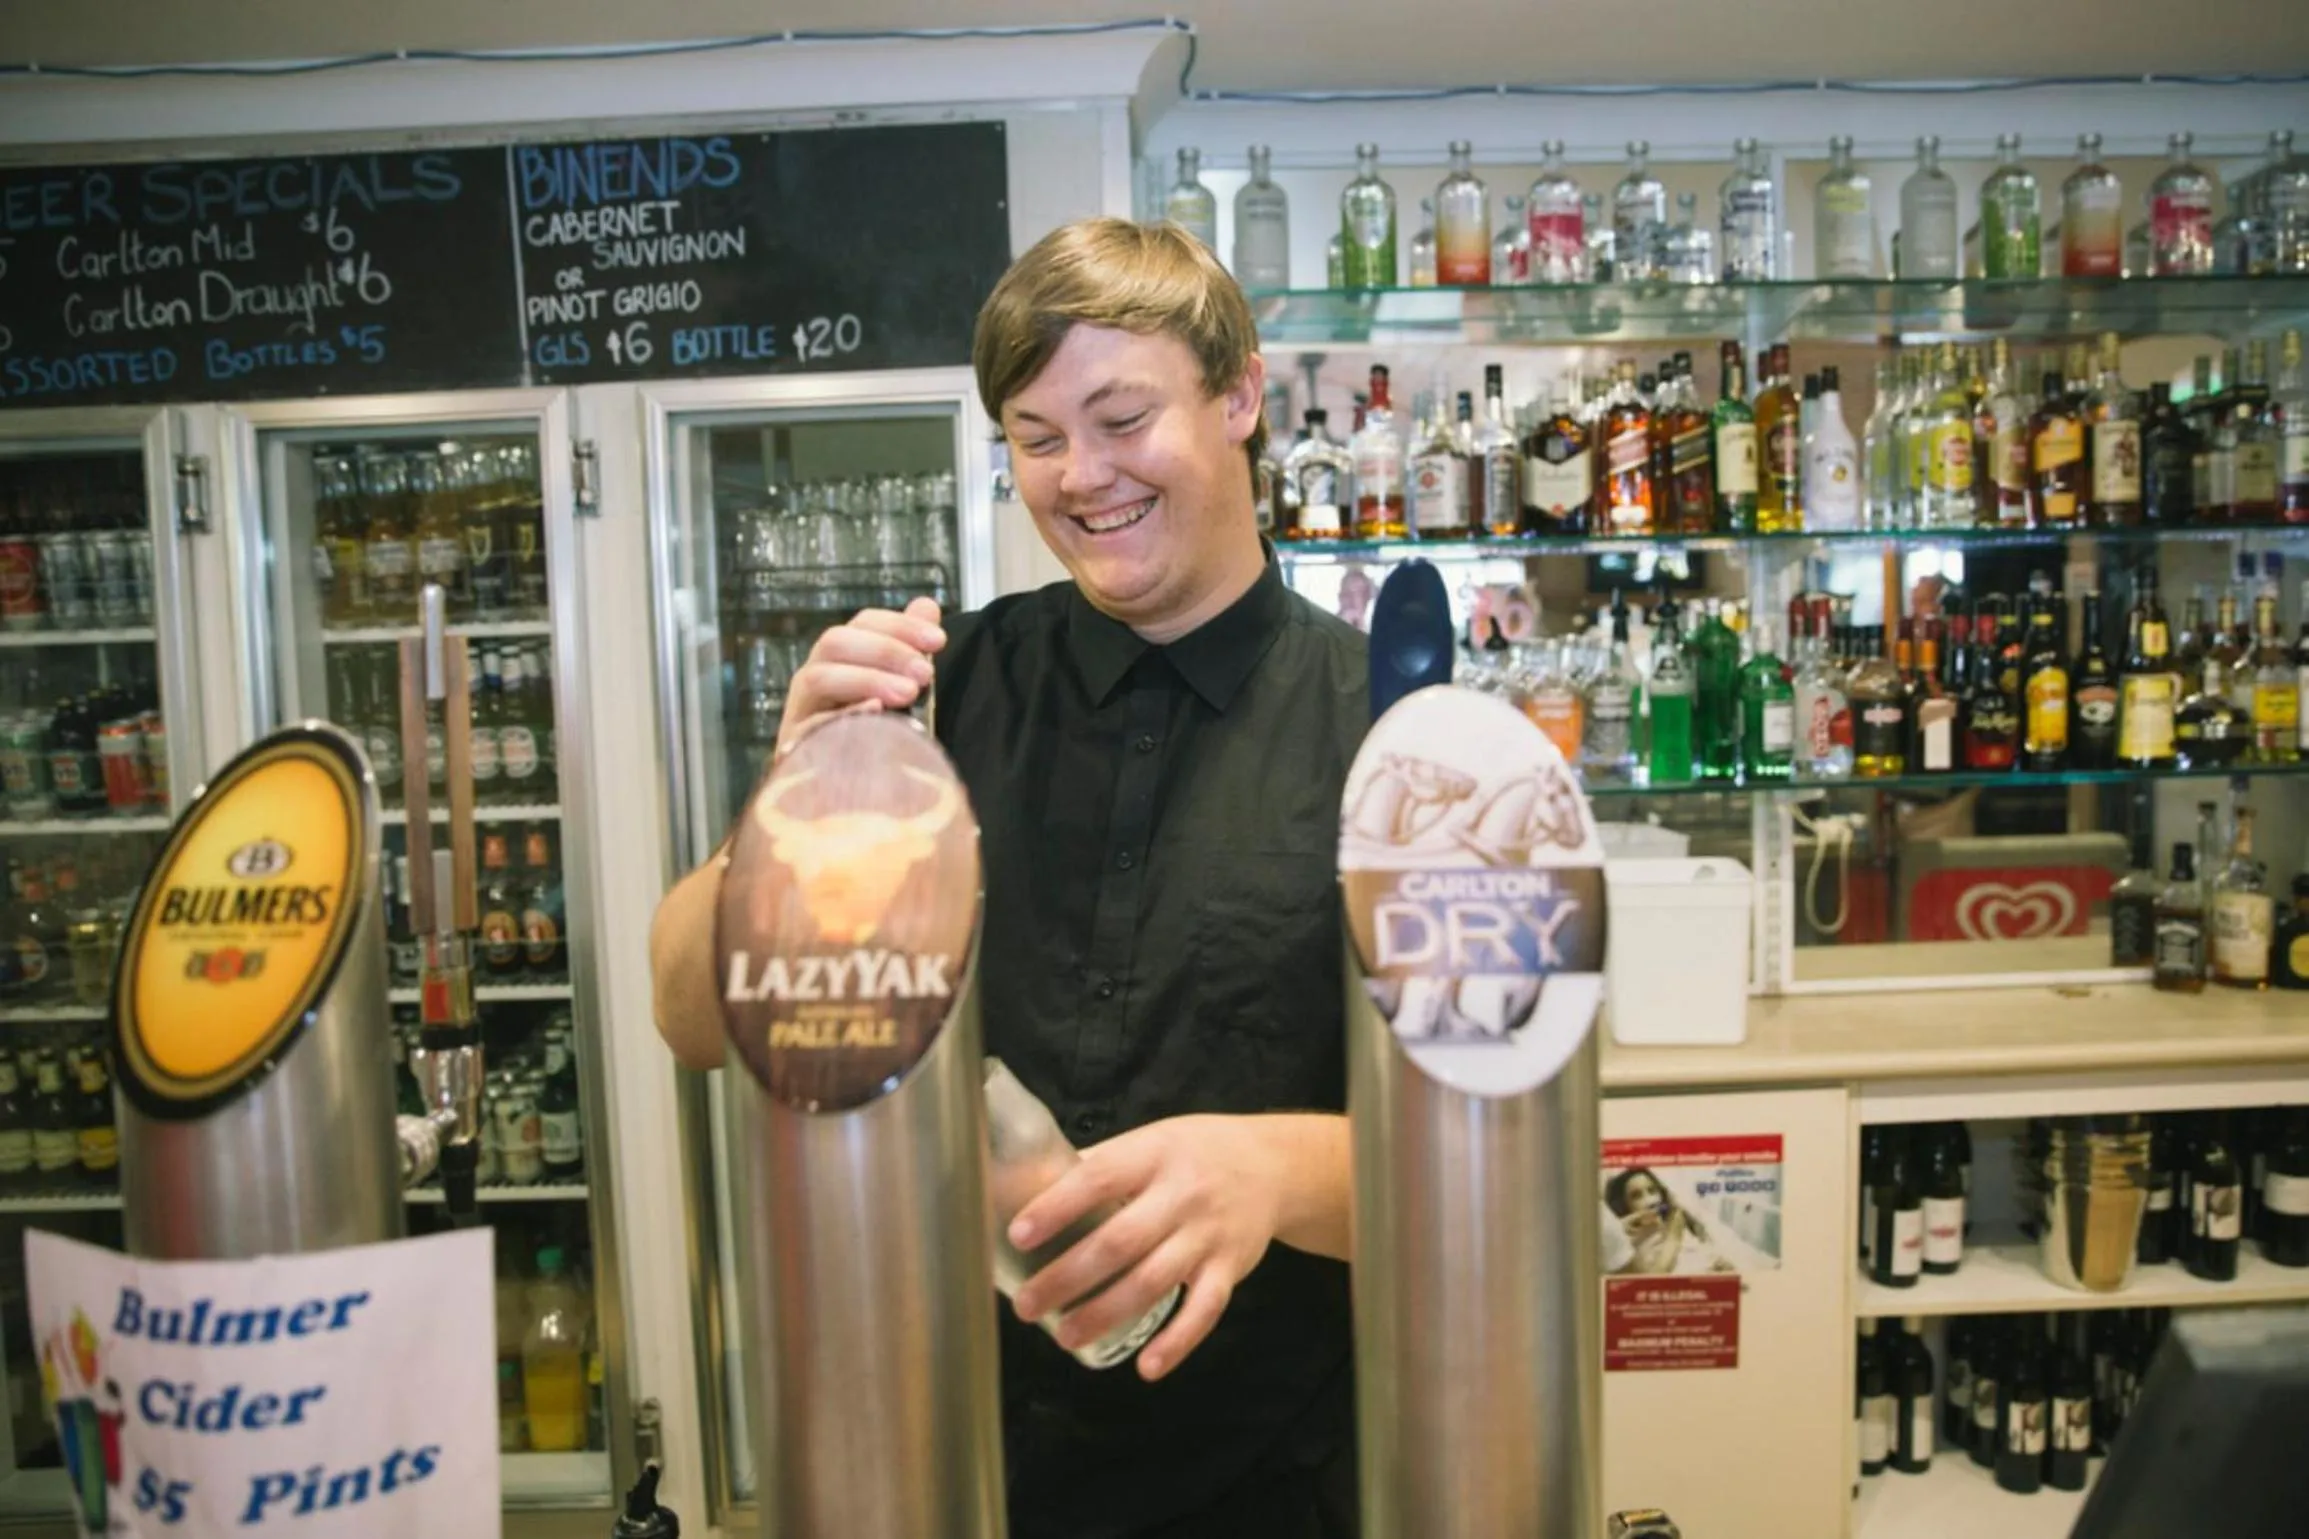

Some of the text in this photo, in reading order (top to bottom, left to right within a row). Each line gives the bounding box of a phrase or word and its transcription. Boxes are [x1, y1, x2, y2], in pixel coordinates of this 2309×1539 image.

[0, 153, 462, 229] EER SPECIALS
[56, 229, 184, 279] Carlton
[192, 221, 255, 263] Mid
[303, 206, 355, 252] $6
[525, 200, 681, 246] CABERNET
[592, 226, 746, 270] SAUVIGNON
[64, 284, 193, 338] Carlton
[199, 260, 345, 335] Draught
[339, 251, 392, 305] $6
[528, 280, 702, 326] PINOT GRIGIO
[555, 267, 585, 291] OR
[340, 324, 386, 364] $5
[536, 313, 862, 367] GLS $6 BOTTLE $20
[158, 883, 333, 926] BULMERS
[1400, 872, 1550, 898] CARLTON
[1372, 898, 1582, 970] DRY
[768, 1018, 898, 1049] PALE ALE
[111, 1286, 371, 1346] Bulmer
[137, 1379, 327, 1434] Cider
[133, 1443, 442, 1527] $5 Pints
